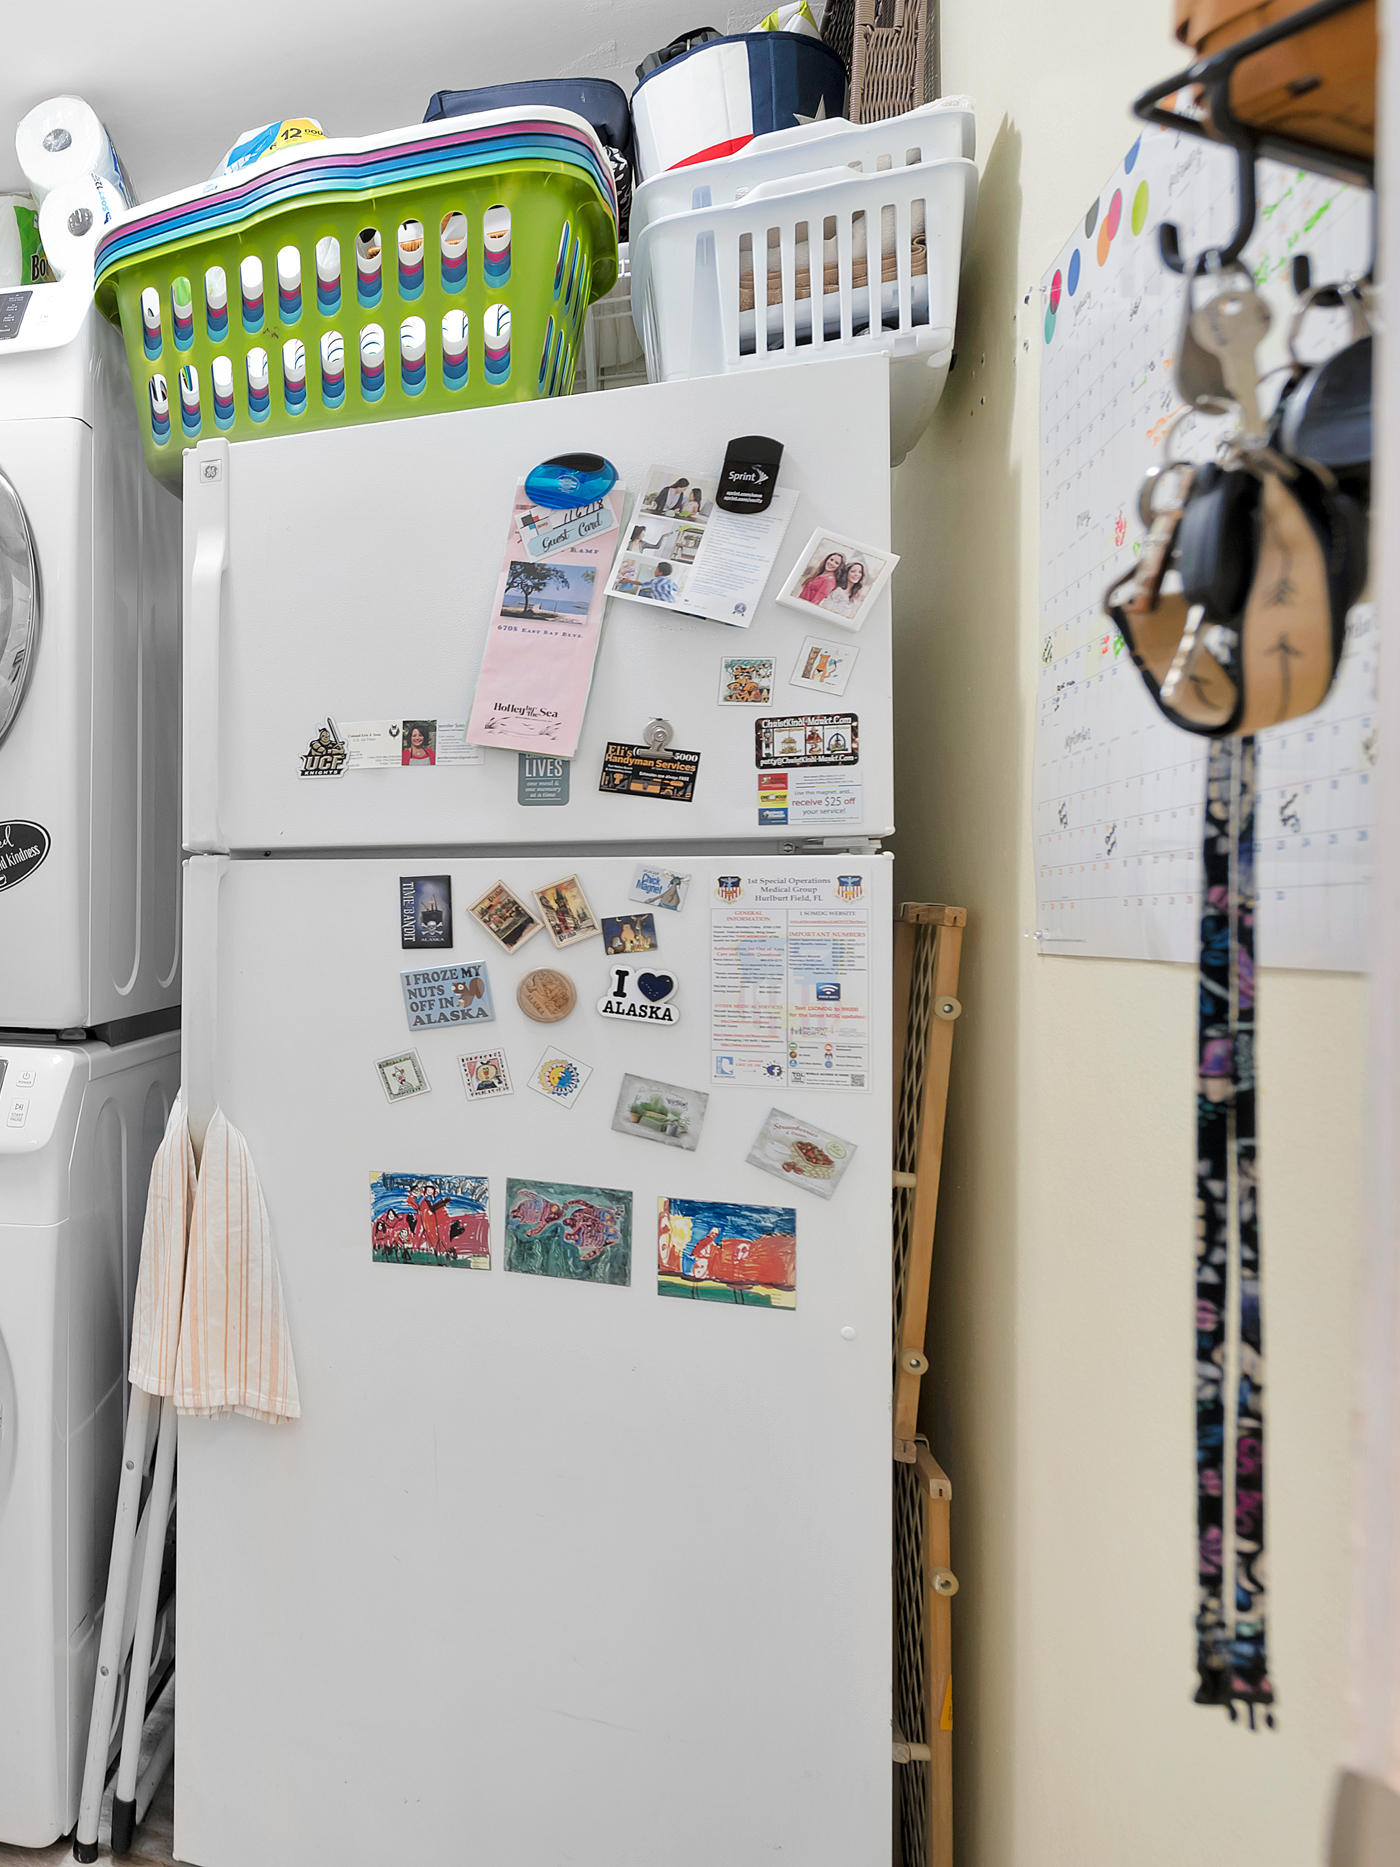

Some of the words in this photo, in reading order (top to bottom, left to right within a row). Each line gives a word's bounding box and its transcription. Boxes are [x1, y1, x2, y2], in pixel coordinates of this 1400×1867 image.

[281, 128, 302, 141] 12
[99, 191, 109, 212] SOFT
[728, 471, 757, 482] Sprint
[542, 527, 572, 553] Guest
[578, 512, 603, 537] Card
[494, 702, 525, 716] Holley
[540, 707, 558, 718] Sea
[608, 745, 633, 757] Eli's
[306, 755, 344, 770] UCF
[525, 759, 563, 777] LIVES
[605, 752, 654, 767] Handyman
[655, 759, 696, 771] Services
[792, 798, 822, 806] receive
[825, 797, 841, 807] $25
[844, 797, 856, 805] off
[820, 807, 846, 815] service!
[6, 845, 40, 867] kindness
[636, 880, 663, 894] Magnet
[760, 878, 787, 886] Special
[788, 878, 831, 886] Operations
[792, 886, 818, 894] Group
[402, 882, 415, 906] TIME
[790, 895, 812, 903] Field,
[402, 907, 416, 942] BANDIT
[404, 975, 411, 986] I
[414, 969, 459, 985] FROZE
[461, 965, 482, 977] MY
[613, 969, 629, 998] I
[407, 985, 445, 1000] NUTS
[410, 999, 436, 1013] OFF
[439, 997, 455, 1009] IN
[602, 1000, 673, 1021] ALASKA
[412, 1007, 488, 1027] ALASKA
